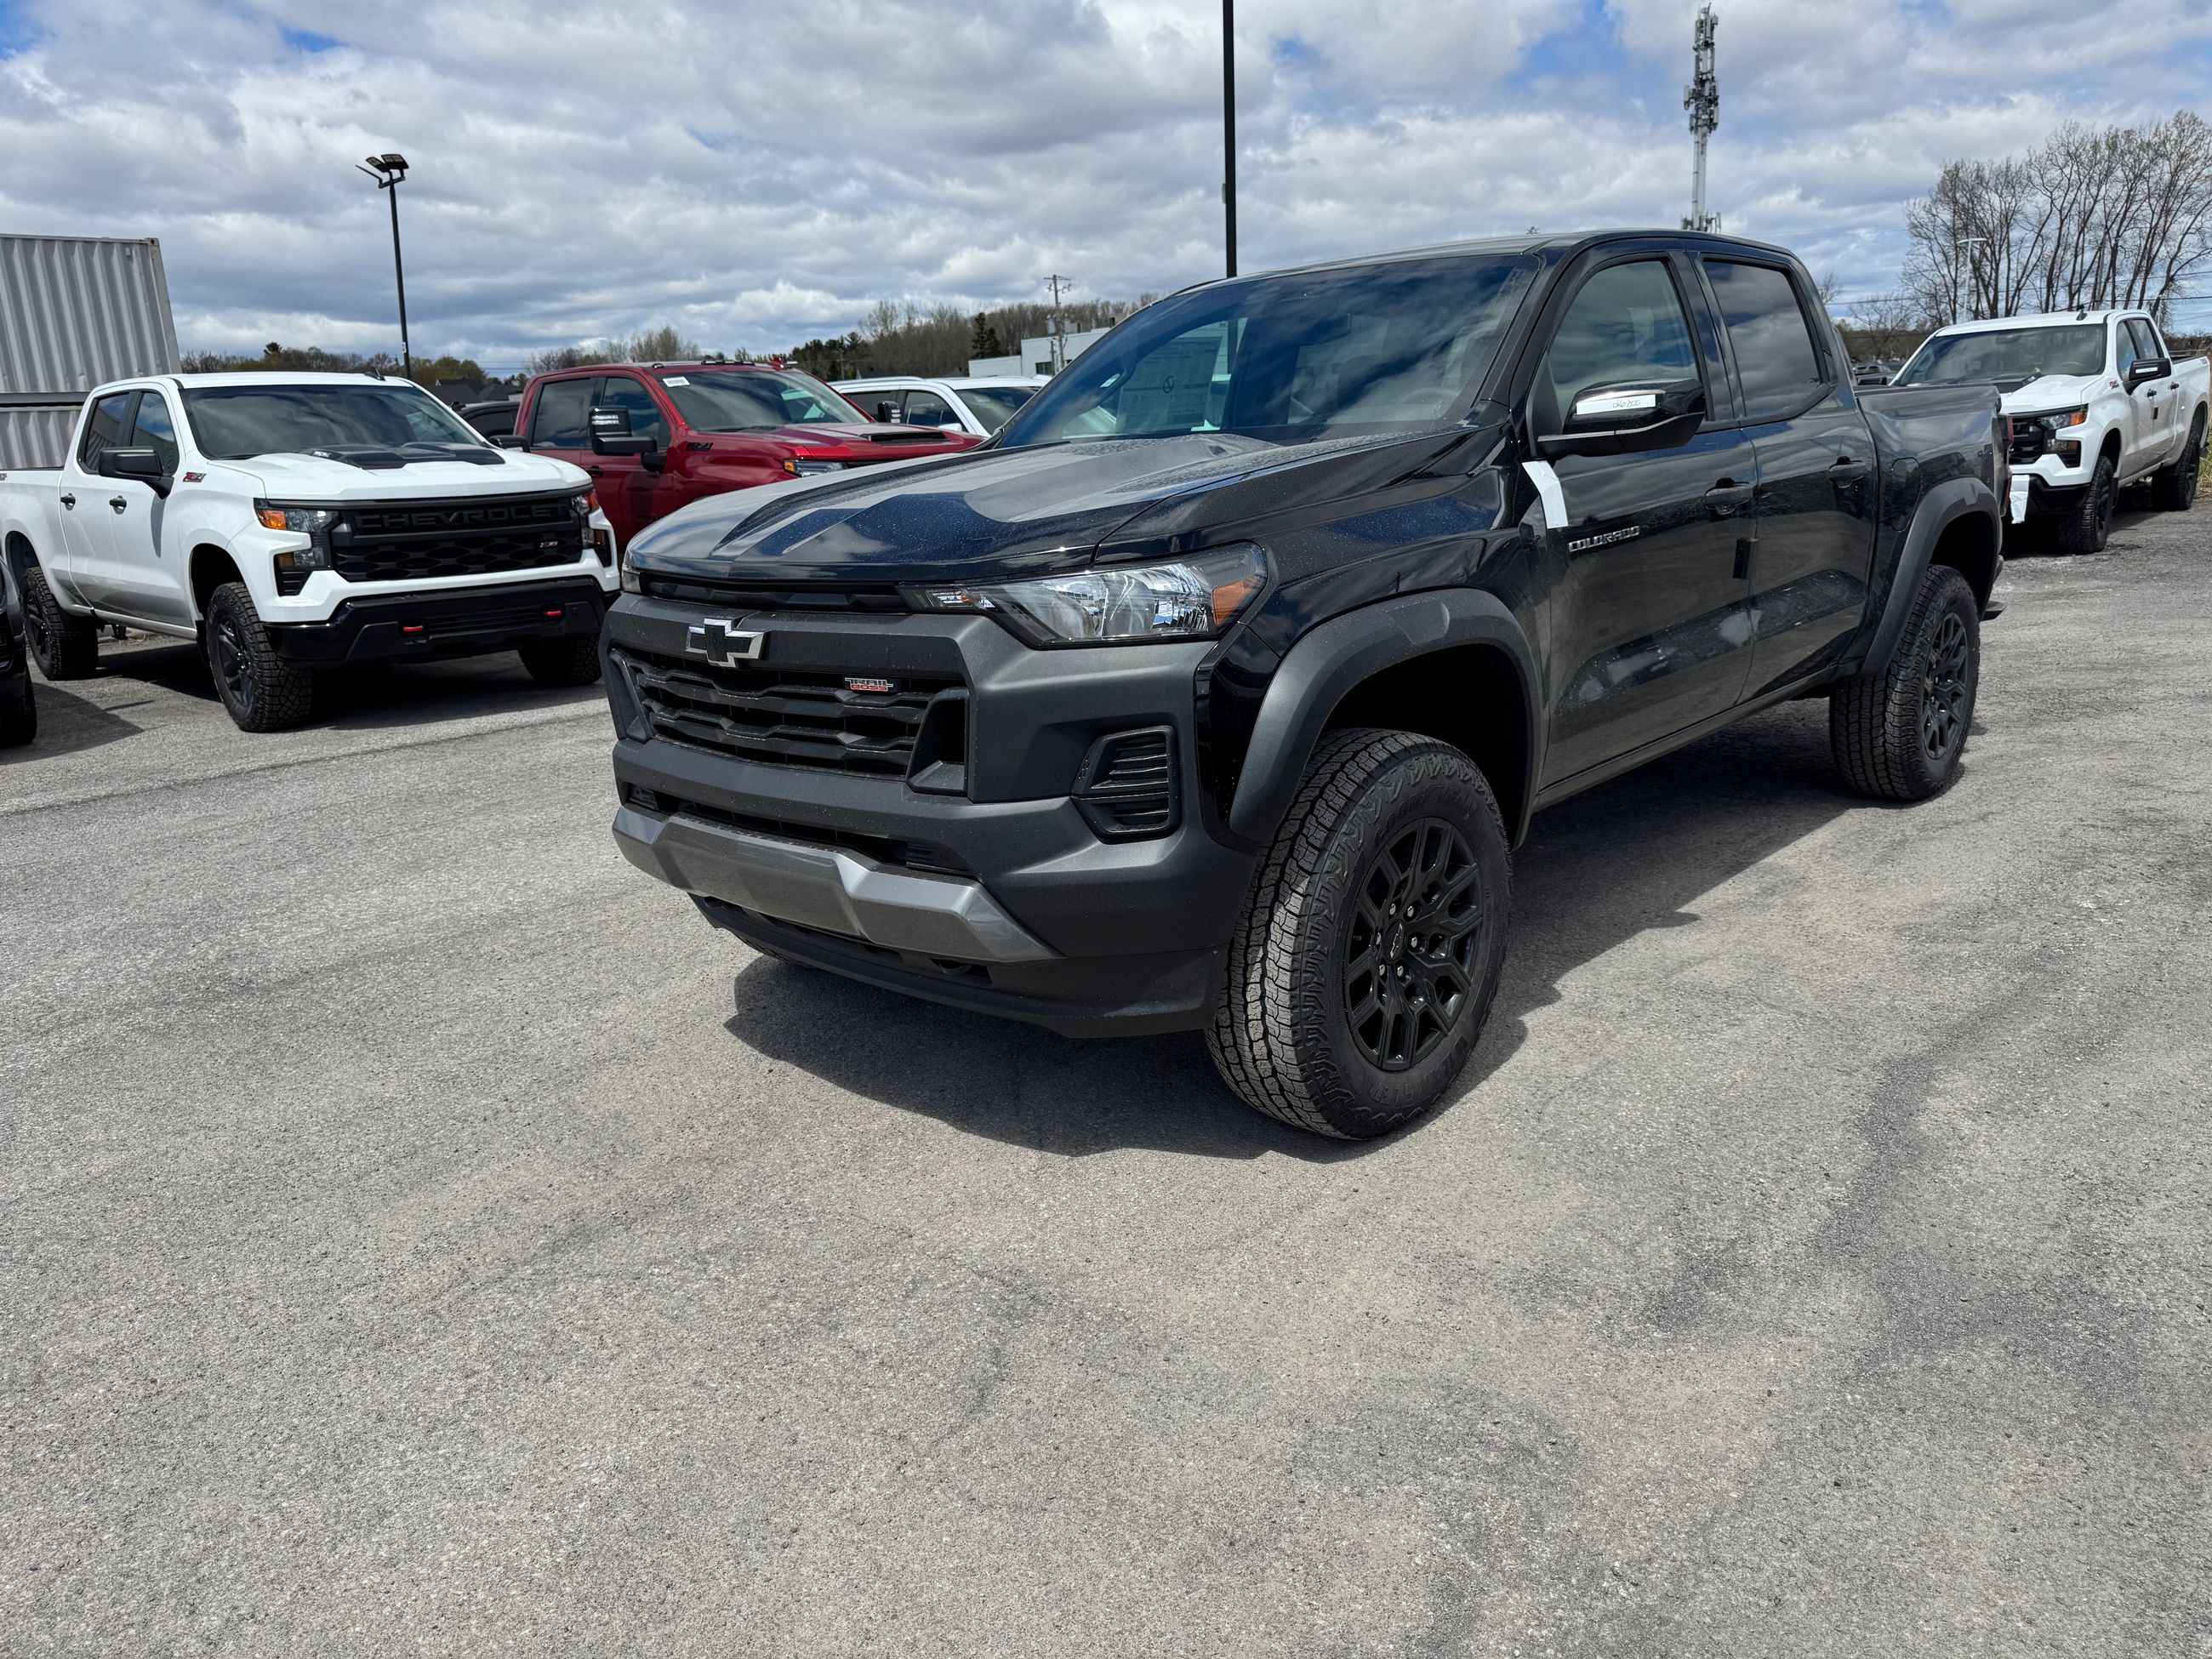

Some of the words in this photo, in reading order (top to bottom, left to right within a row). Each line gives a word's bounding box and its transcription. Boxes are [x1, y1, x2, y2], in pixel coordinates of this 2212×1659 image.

[355, 504, 570, 528] CHEVROLET
[1569, 526, 1639, 552] COLORADO
[845, 677, 893, 687] TRAIL
